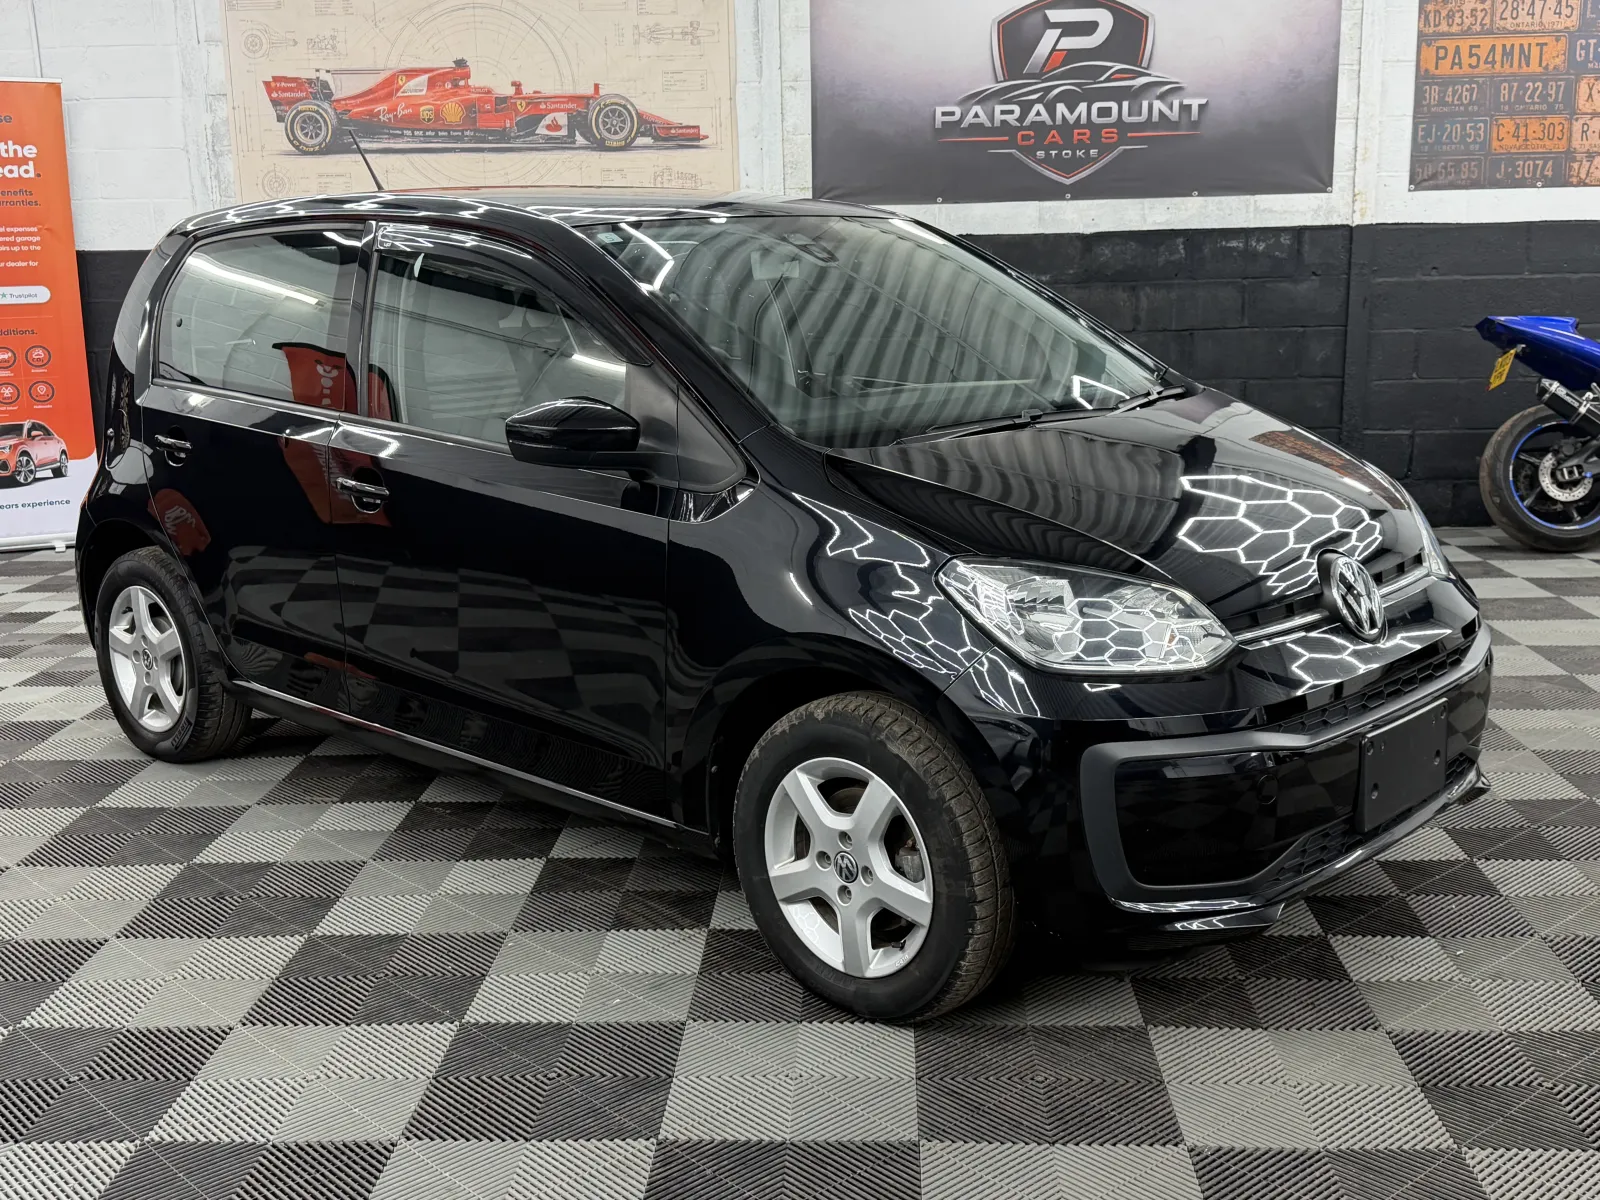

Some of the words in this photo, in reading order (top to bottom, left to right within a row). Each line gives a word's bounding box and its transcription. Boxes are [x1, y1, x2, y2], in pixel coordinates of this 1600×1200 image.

[1434, 42, 1548, 70] PA54MNT
[278, 89, 306, 98] Santander
[546, 101, 577, 109] Santander
[374, 102, 413, 123] Ray-Ban
[934, 98, 1208, 129] PARAMOUNT
[1017, 129, 1119, 146] CARS
[0, 140, 38, 158] the
[1036, 149, 1099, 159] STOKE
[0, 160, 42, 178] ad.
[0, 198, 41, 206] rranties.
[6, 226, 38, 234] expenses
[21, 499, 71, 509] experience
